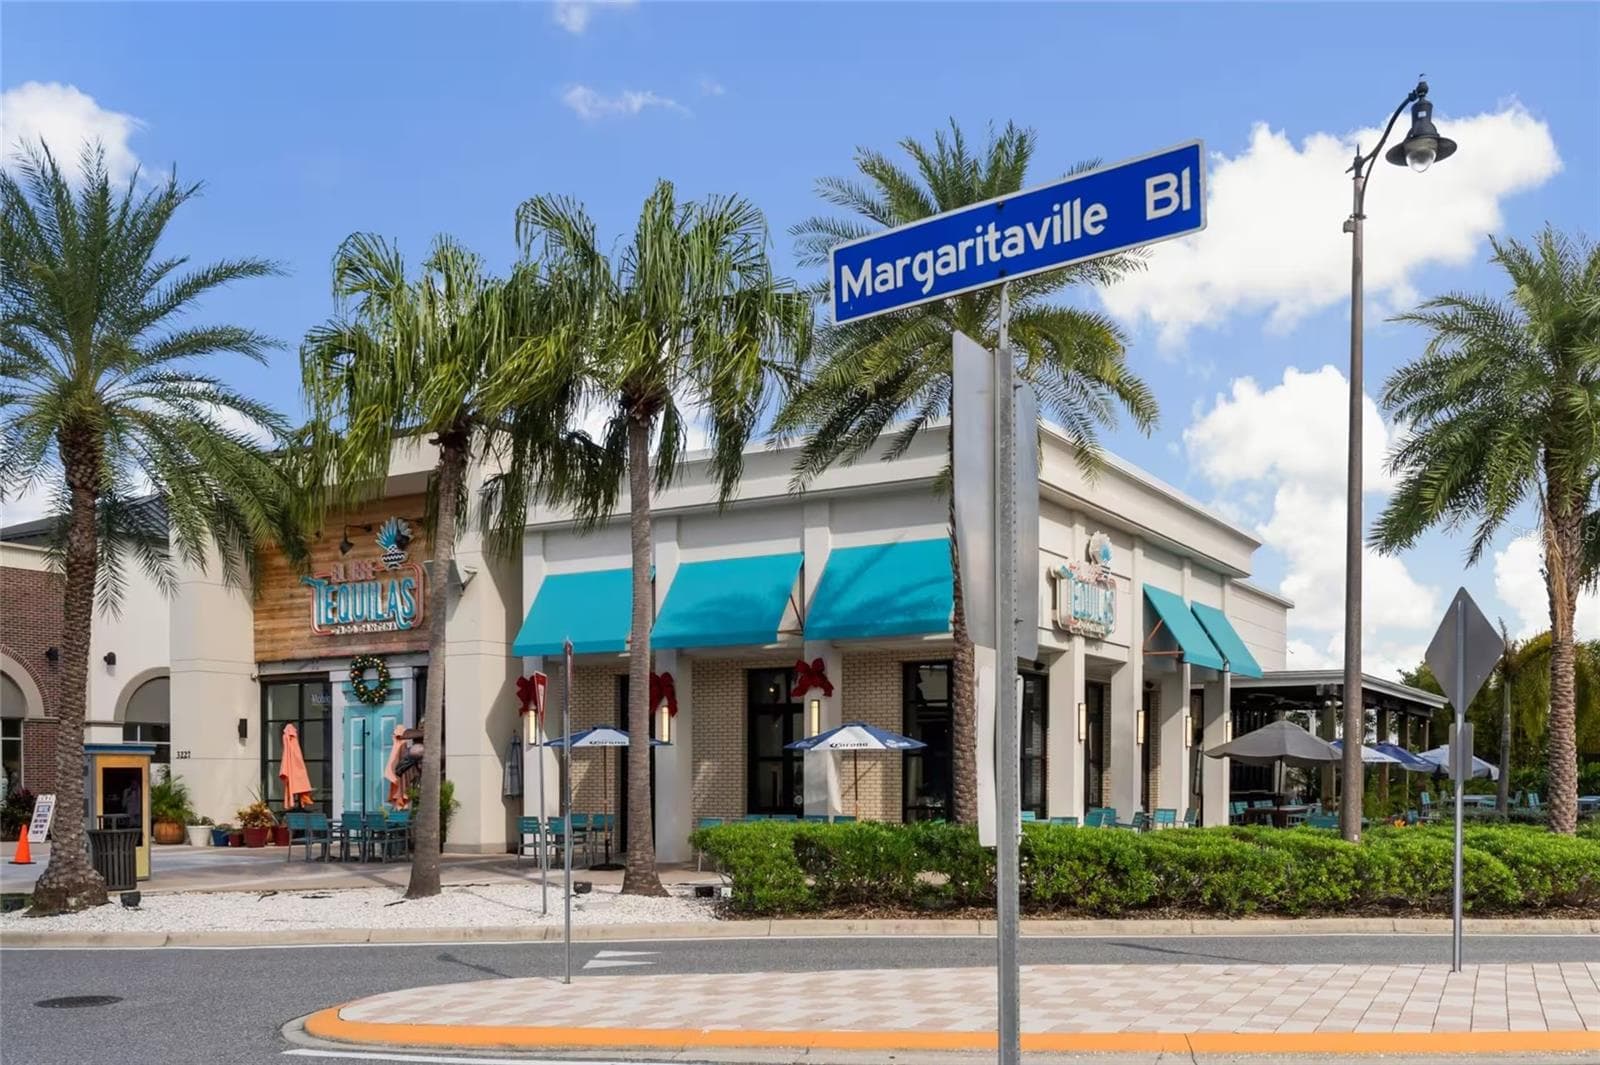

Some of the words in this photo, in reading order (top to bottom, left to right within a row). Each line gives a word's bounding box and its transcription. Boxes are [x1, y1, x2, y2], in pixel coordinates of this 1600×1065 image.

[841, 198, 1108, 303] Margaritaville
[1145, 167, 1192, 221] Bl
[302, 576, 416, 630] TEQUILAS
